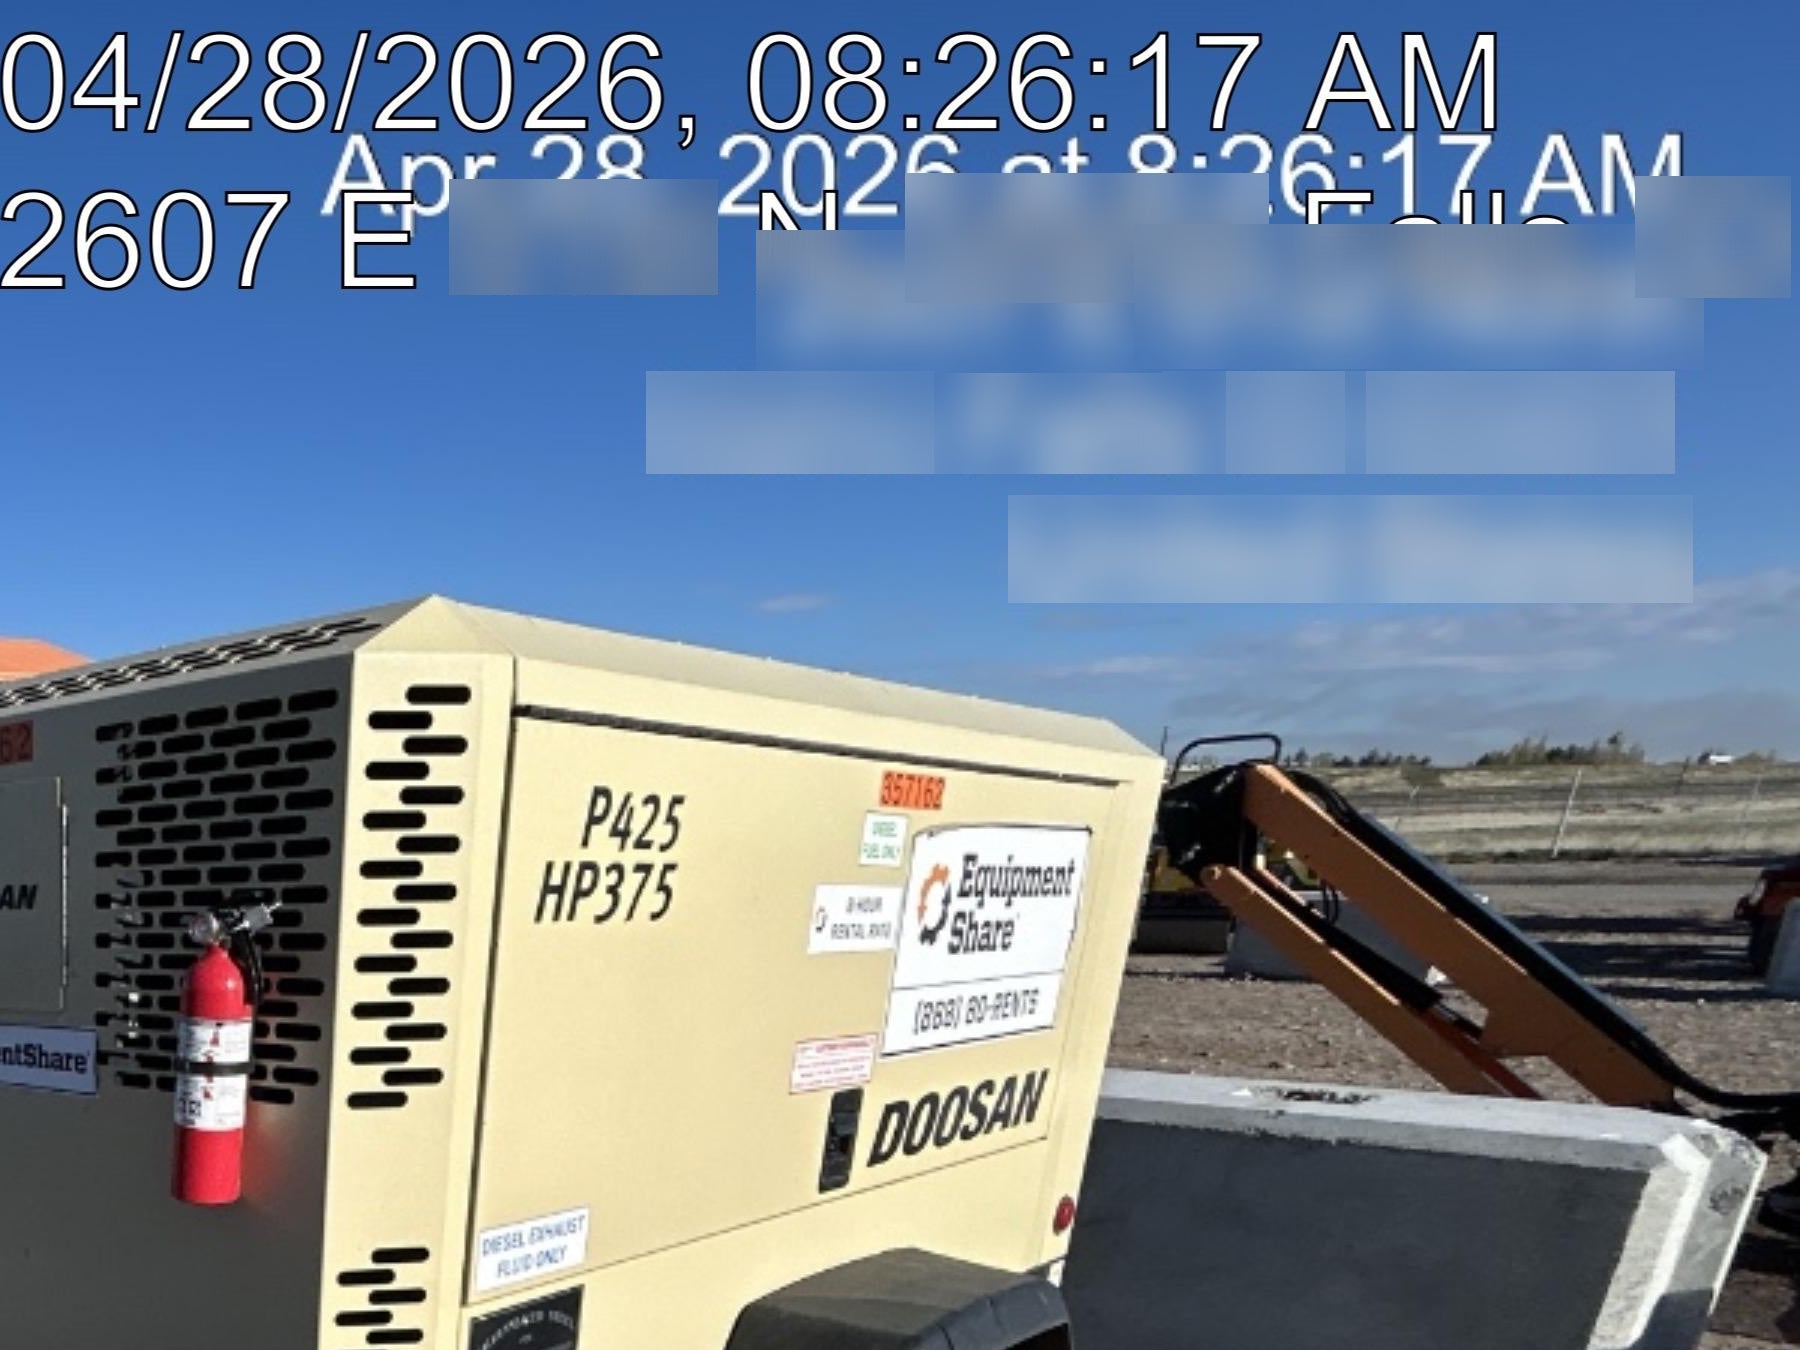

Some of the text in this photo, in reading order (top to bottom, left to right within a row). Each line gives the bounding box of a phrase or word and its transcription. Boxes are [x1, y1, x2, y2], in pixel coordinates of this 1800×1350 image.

[581, 785, 686, 852] P425
[534, 861, 678, 923] HP375
[957, 854, 1076, 908] Equipment
[948, 910, 1015, 954] Share
[866, 1067, 1050, 1169] DOOSAN
